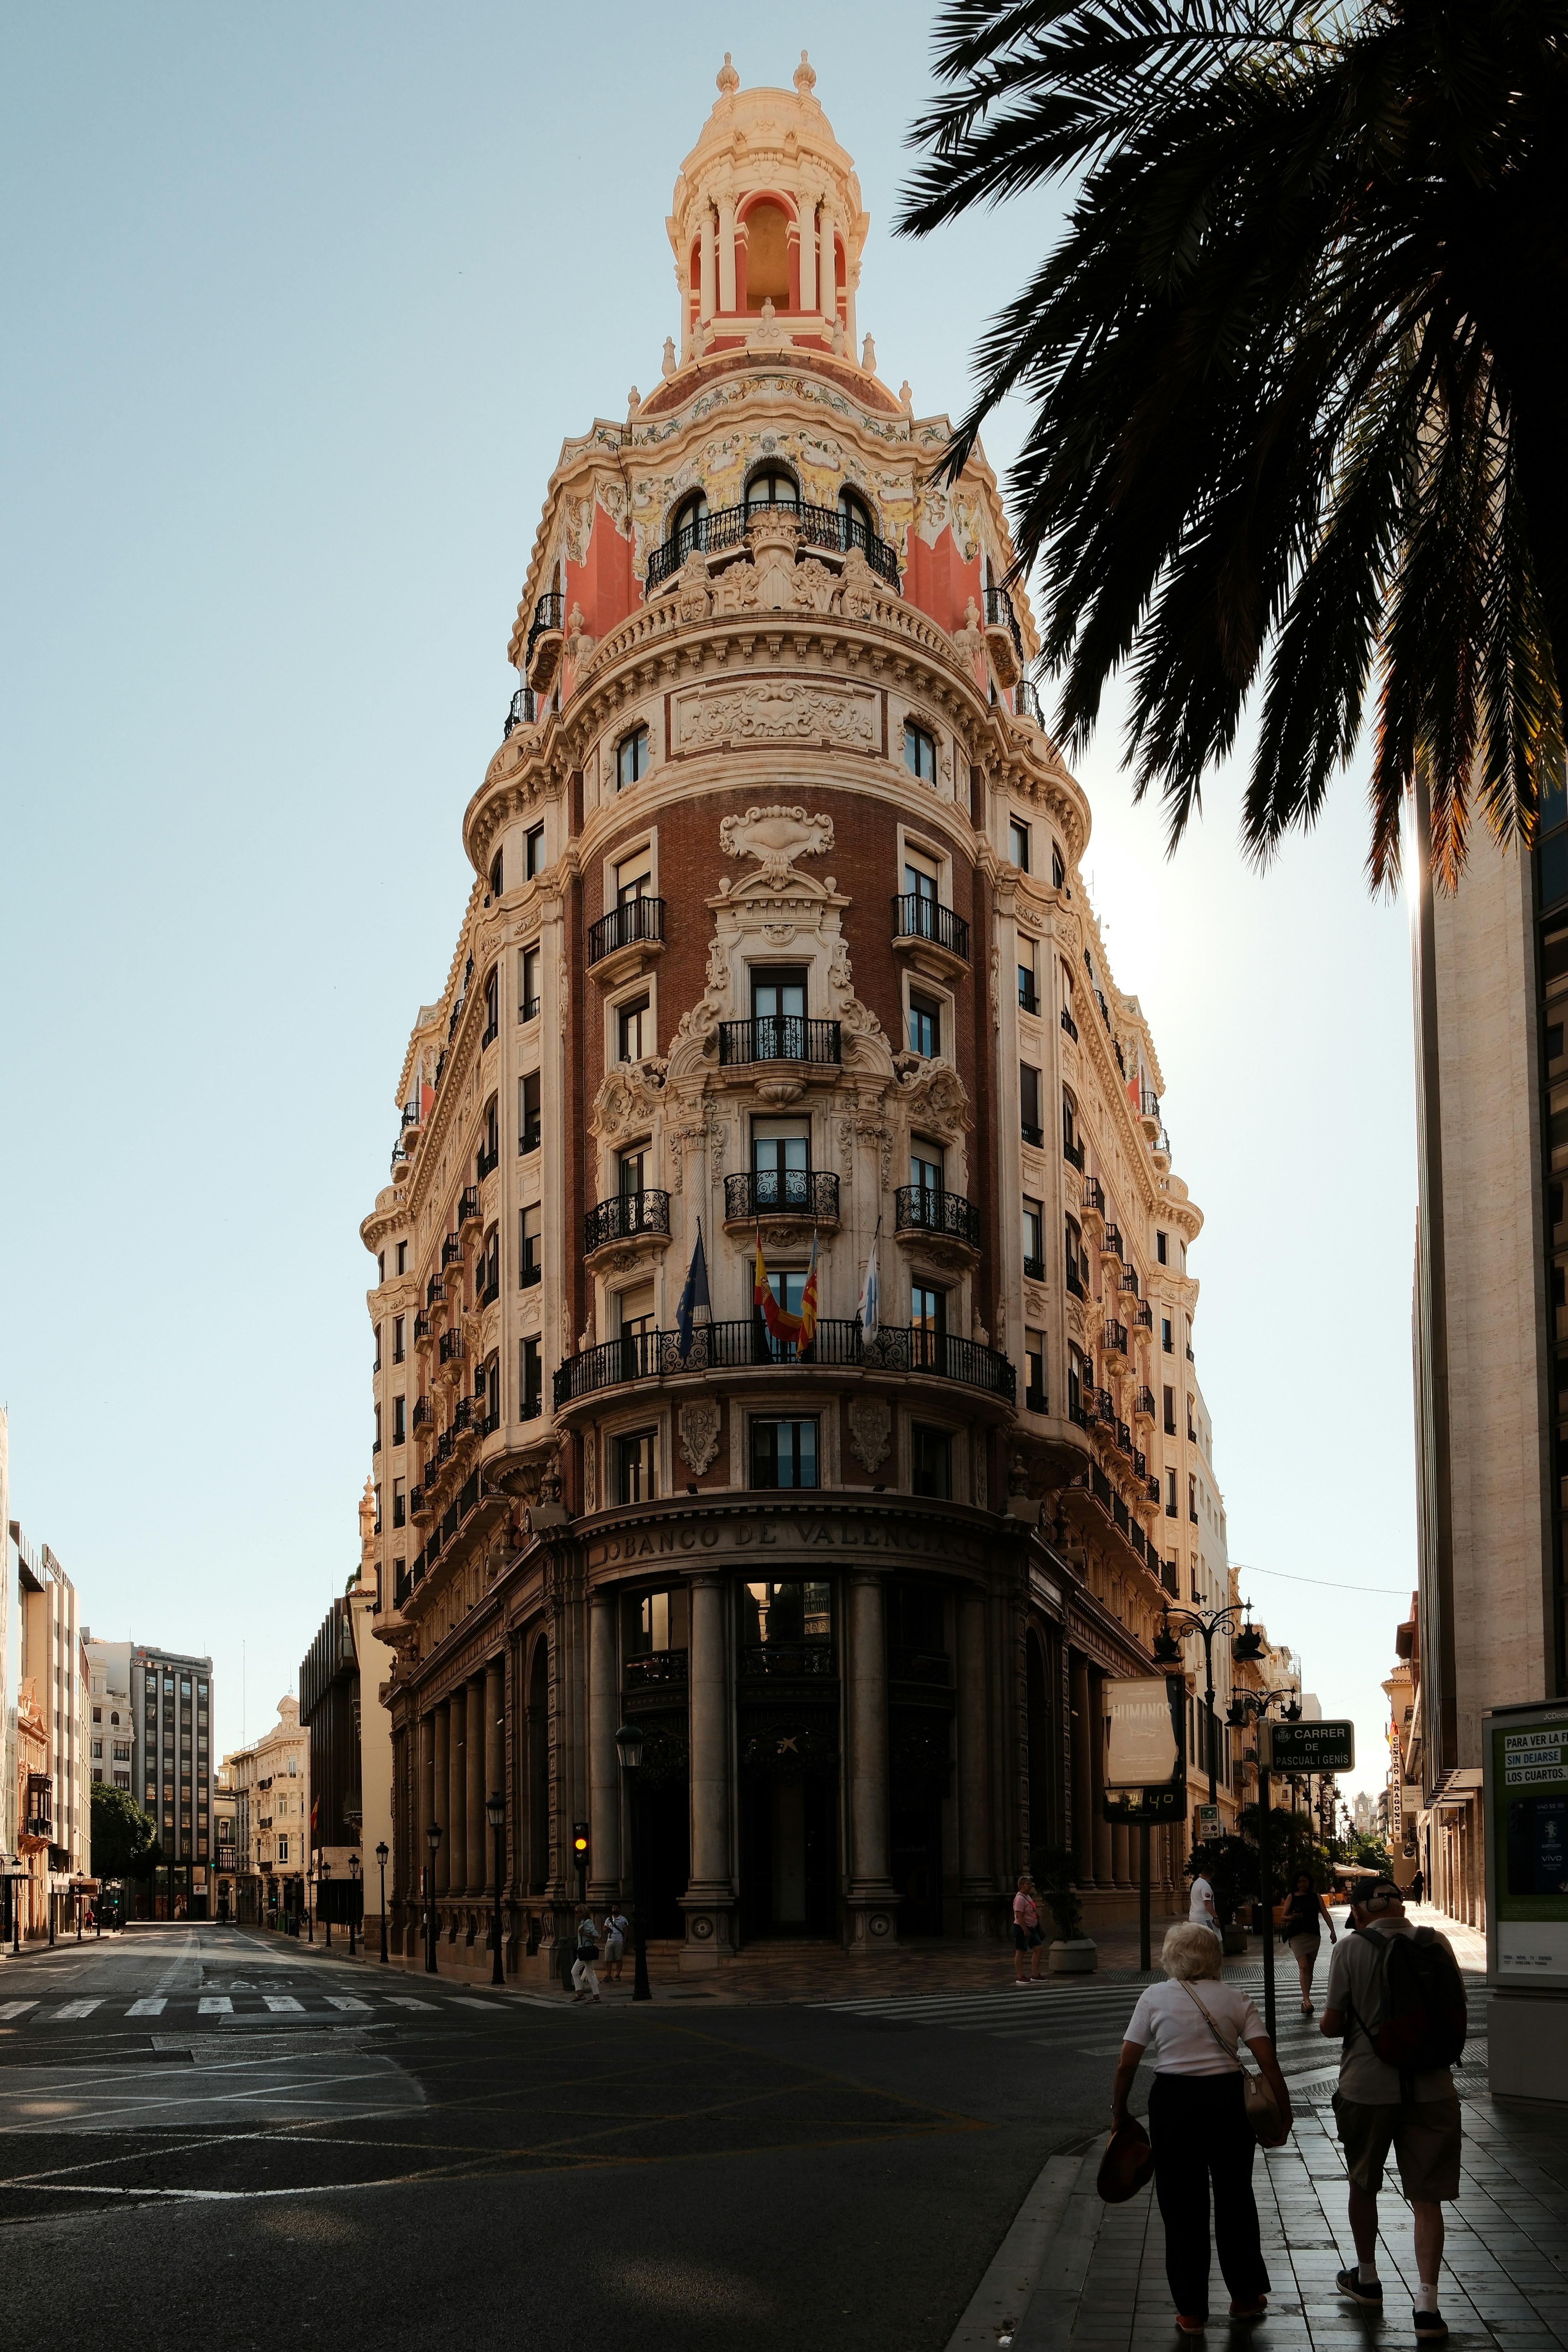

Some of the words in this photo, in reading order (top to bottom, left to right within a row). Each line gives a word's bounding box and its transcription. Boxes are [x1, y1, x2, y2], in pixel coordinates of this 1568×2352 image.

[624, 1526, 718, 1558] BANCO
[735, 1522, 776, 1545] DE
[793, 1522, 948, 1554] VALENCIA
[1112, 1702, 1173, 1720] HUMANOS
[1294, 1728, 1345, 1739] CARRER
[1507, 1737, 1528, 1748] PARA
[1530, 1735, 1546, 1745] VER
[1549, 1733, 1559, 1743] LA
[1305, 1743, 1319, 1751] DE
[1276, 1756, 1315, 1766] PASCUAL
[1317, 1756, 1320, 1765] I
[1322, 1752, 1349, 1764] GENÍS
[1507, 1755, 1521, 1765] SIN
[1524, 1751, 1559, 1764] DEJARSE
[1507, 1772, 1522, 1782] LOS
[1525, 1768, 1566, 1781] CUARTOS.
